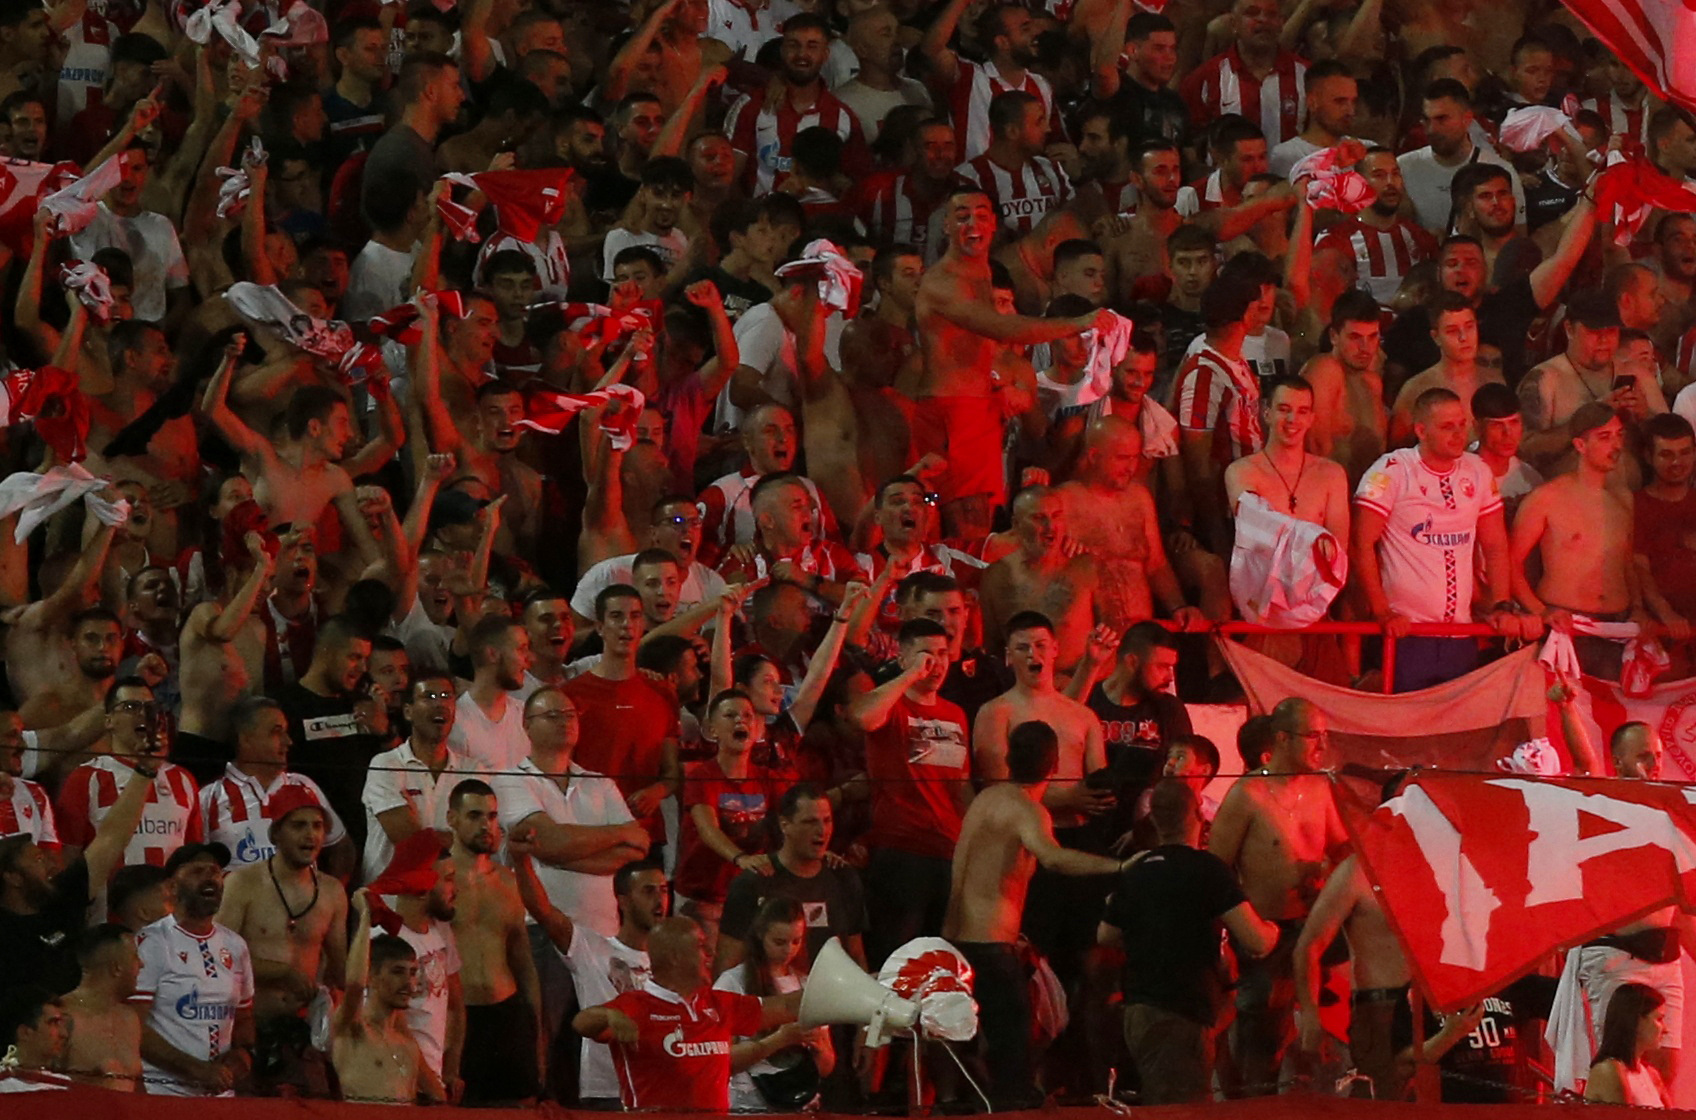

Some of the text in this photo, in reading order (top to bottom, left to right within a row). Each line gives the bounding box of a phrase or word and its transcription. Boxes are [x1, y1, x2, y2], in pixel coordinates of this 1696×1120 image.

[1001, 197, 1054, 218] OYOTA
[310, 721, 356, 733] Champ
[199, 1005, 235, 1020] ГАЗПРО
